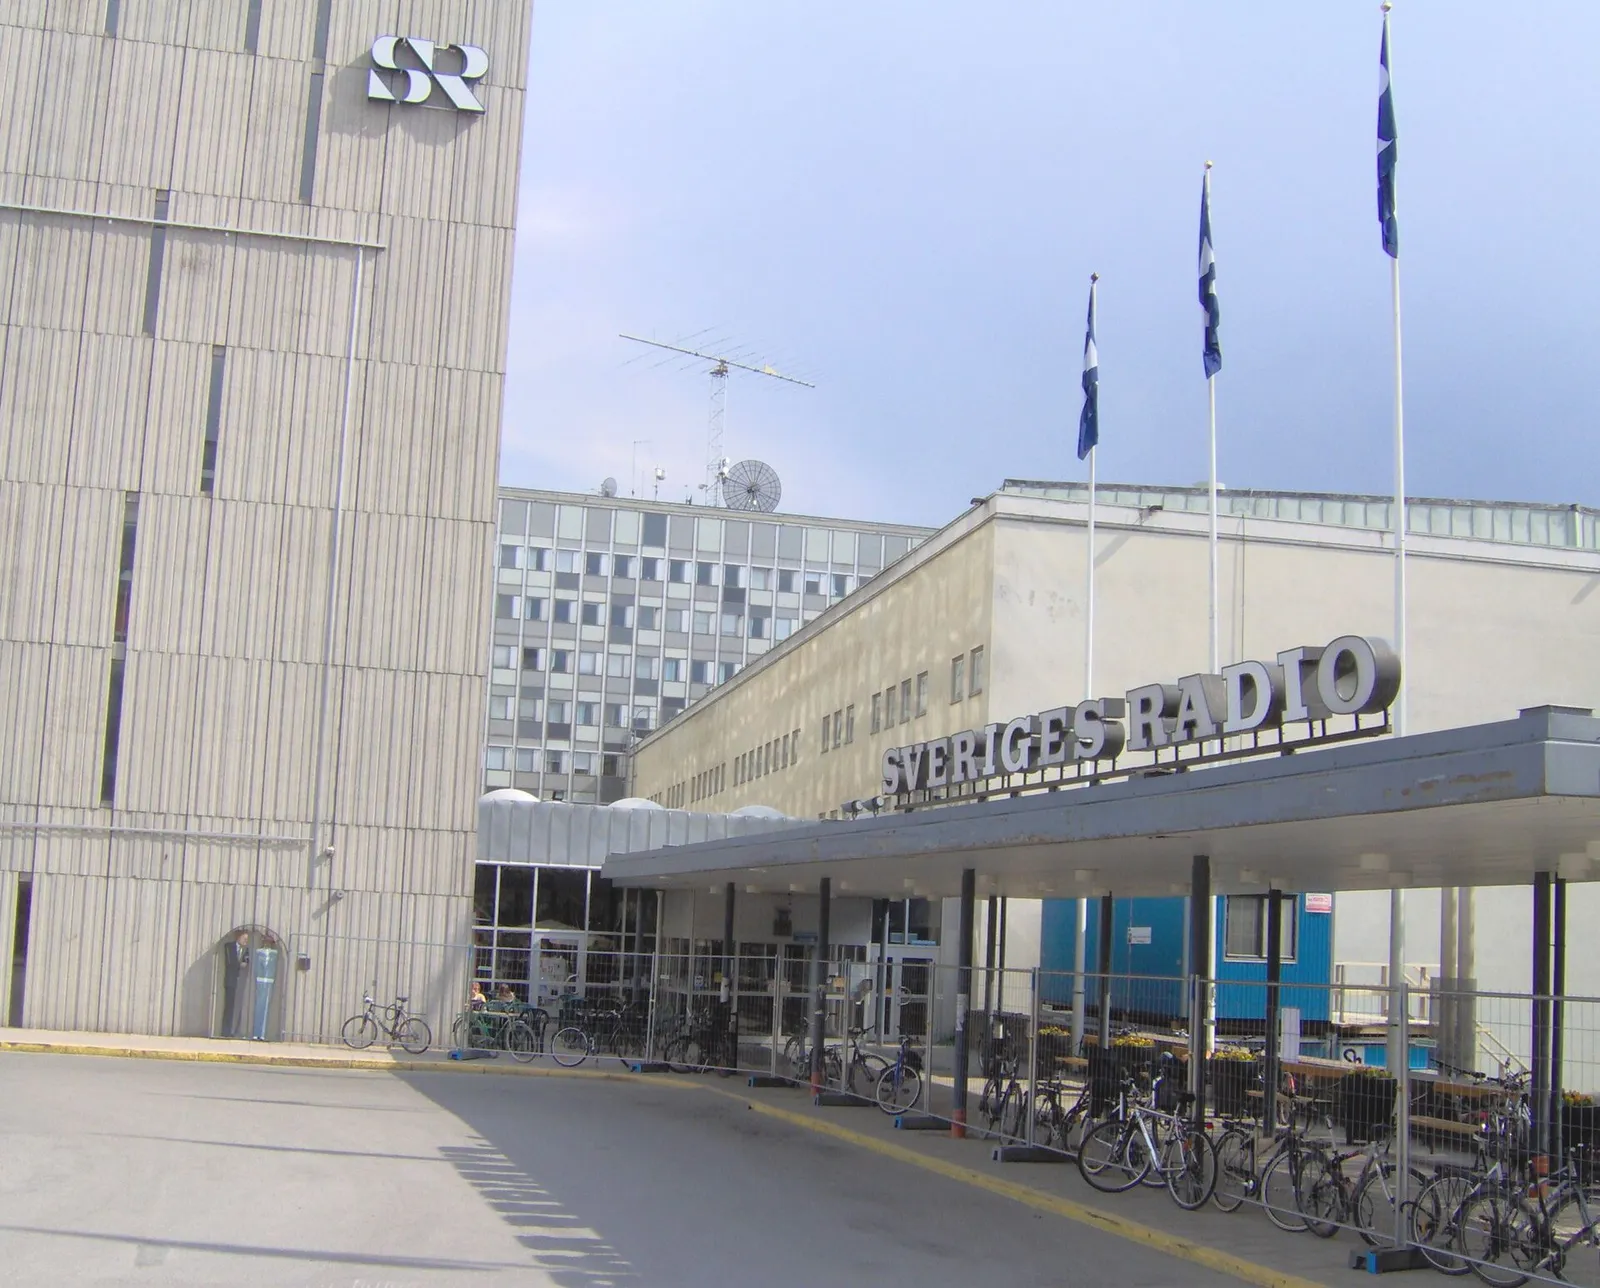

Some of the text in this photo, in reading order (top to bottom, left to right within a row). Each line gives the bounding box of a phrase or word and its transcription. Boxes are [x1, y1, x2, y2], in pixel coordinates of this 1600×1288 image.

[368, 35, 488, 112] SR
[882, 635, 1392, 795] SVERIGES RADIO
